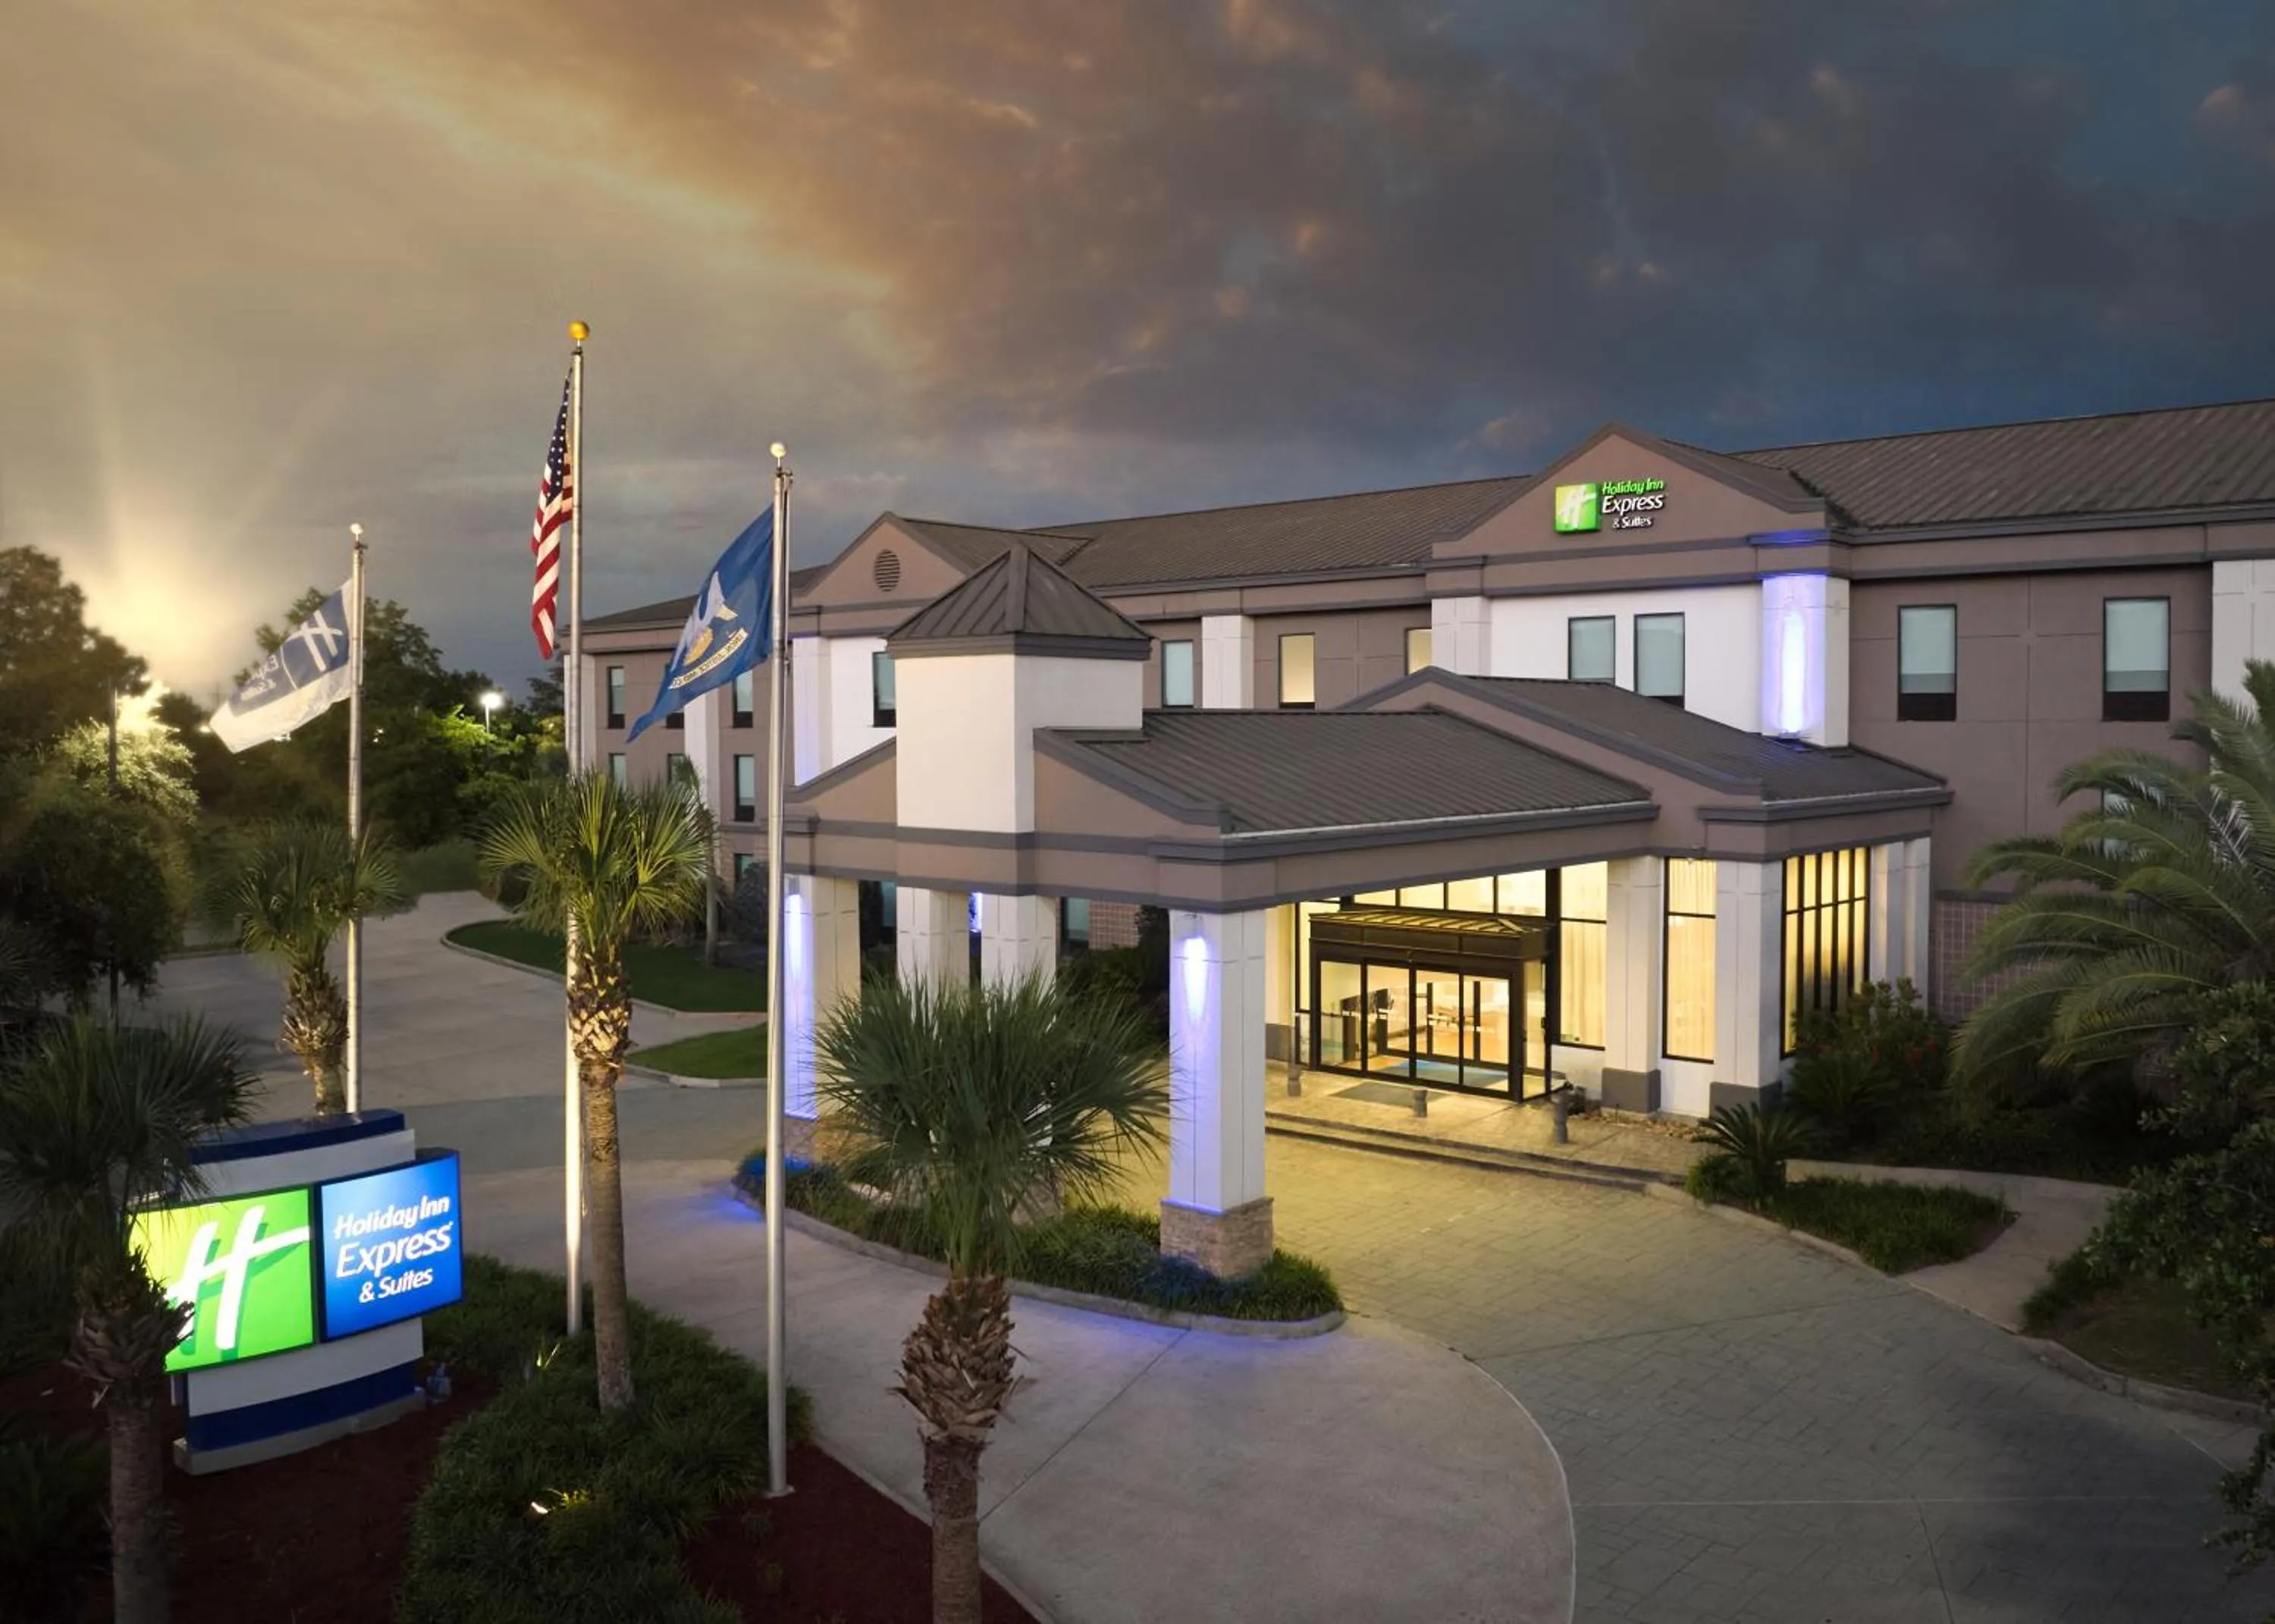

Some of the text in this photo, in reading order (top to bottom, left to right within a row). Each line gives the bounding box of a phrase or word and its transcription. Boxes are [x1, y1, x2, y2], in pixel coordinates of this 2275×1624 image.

[1602, 478, 1663, 495] Holiday Inn
[1602, 494, 1664, 516] Express
[1612, 516, 1652, 529] & Suites
[334, 1195, 450, 1240] Holiday Inn
[336, 1224, 451, 1278] Express
[359, 1268, 433, 1304] & Suites
